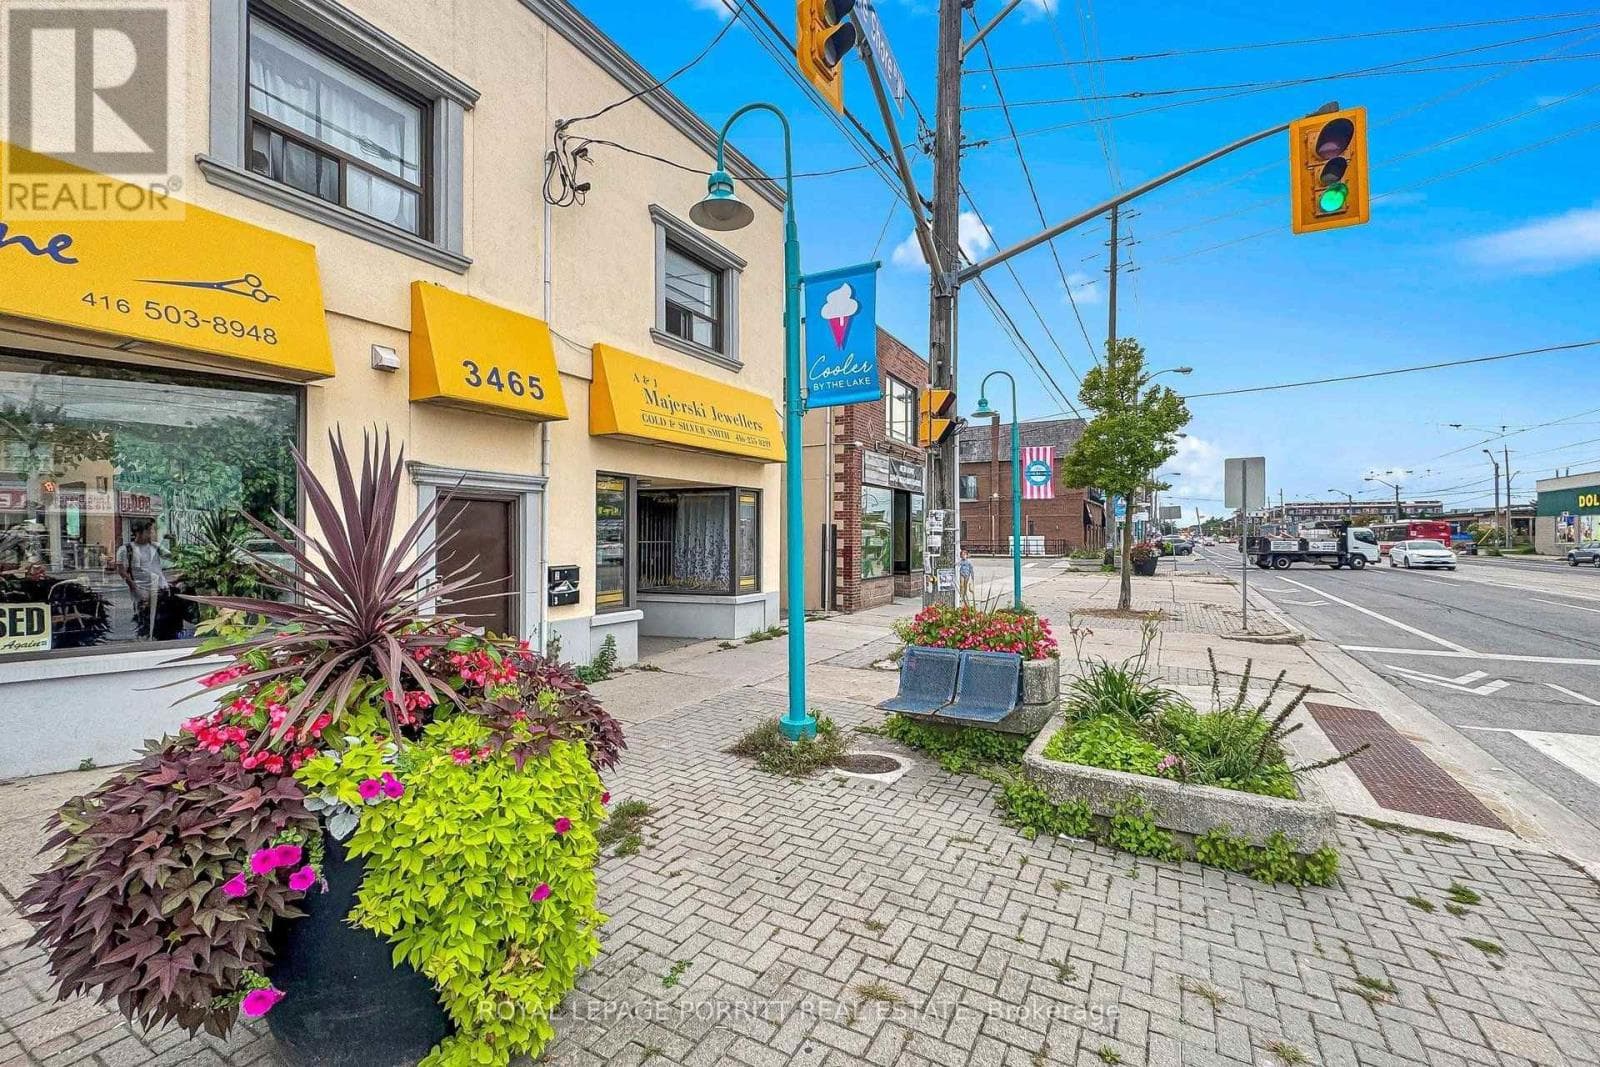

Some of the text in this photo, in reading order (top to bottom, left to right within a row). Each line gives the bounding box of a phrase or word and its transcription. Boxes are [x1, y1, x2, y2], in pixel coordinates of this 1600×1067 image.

[81, 292, 278, 345] 416 503-8948
[462, 360, 545, 400] 3465
[809, 353, 873, 380] Cooler
[813, 377, 871, 391] BY THE LAKE
[643, 387, 763, 432] Majerski Jewellers
[642, 413, 667, 426] GOLD
[669, 419, 676, 428] &
[678, 422, 705, 435] SILVER
[707, 428, 730, 440] SMITH
[1578, 494, 1600, 507] DOL
[1, 639, 41, 650] Again
